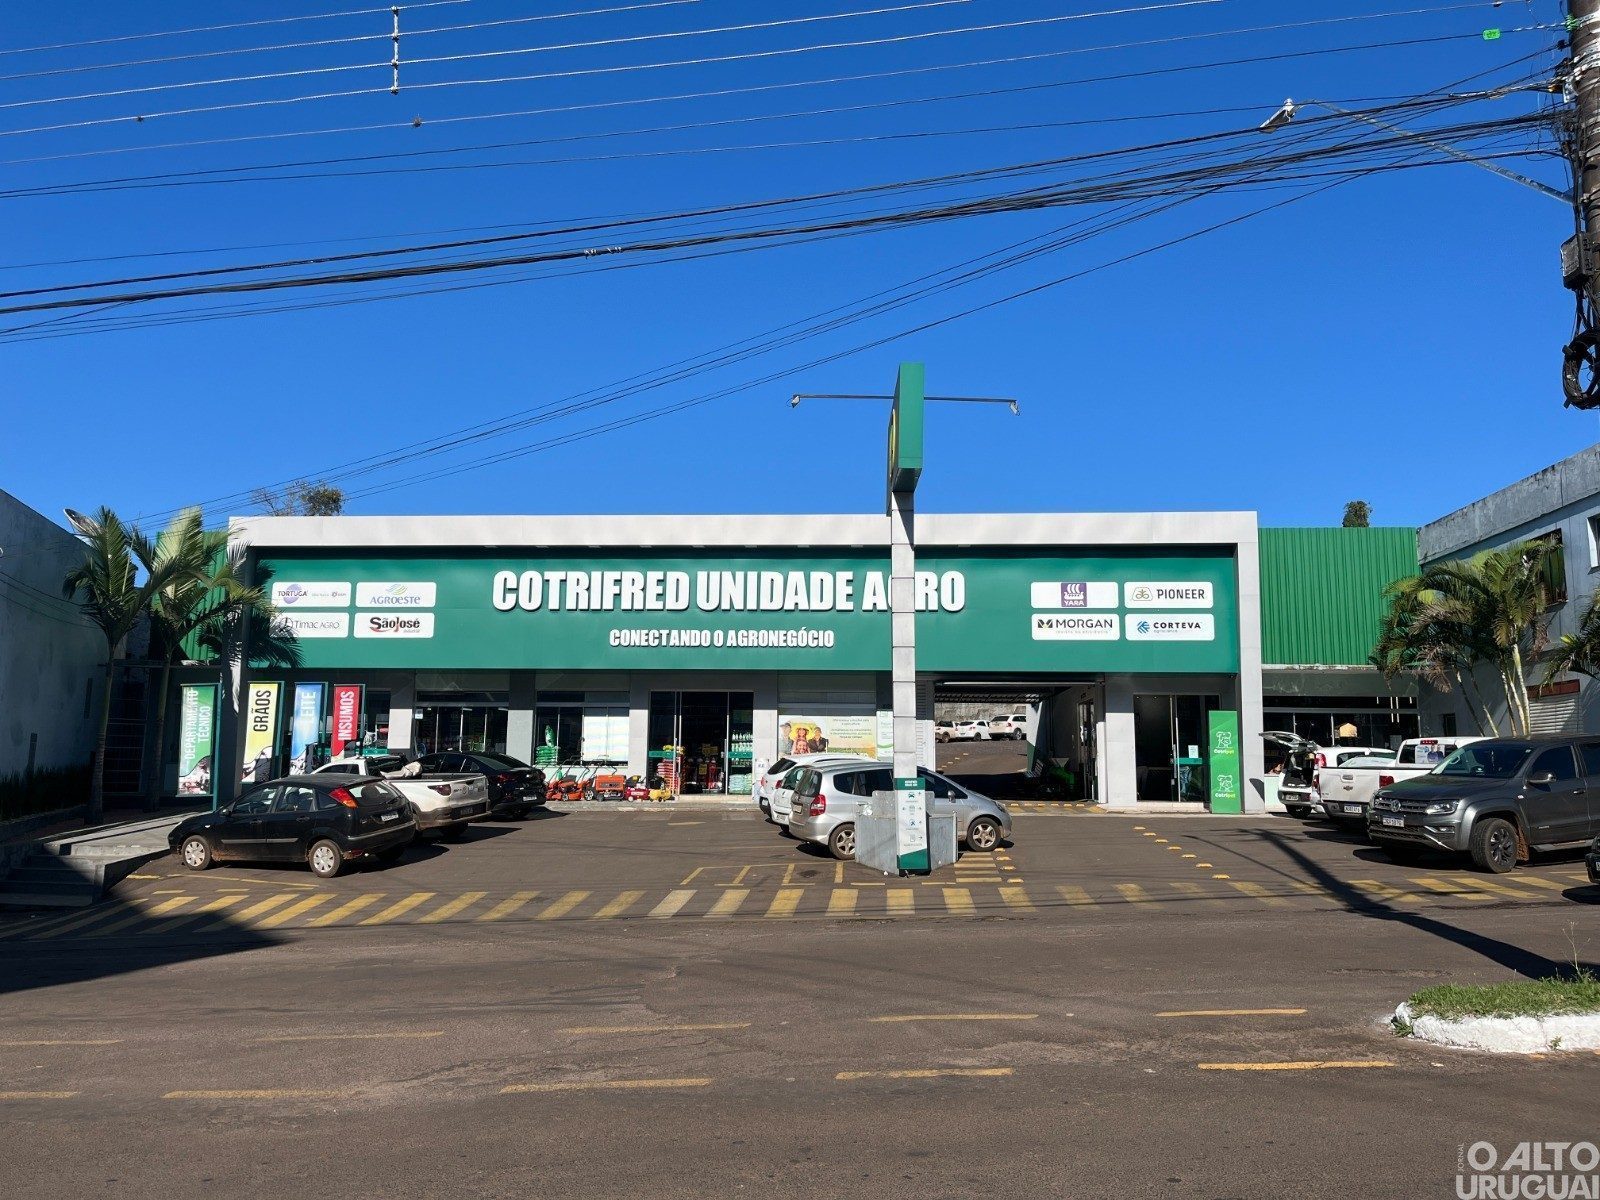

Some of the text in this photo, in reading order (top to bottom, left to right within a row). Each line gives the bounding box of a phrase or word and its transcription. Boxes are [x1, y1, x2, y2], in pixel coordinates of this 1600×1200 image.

[492, 570, 966, 612] COTRIFRED UNIDADE ARO
[1156, 588, 1205, 600] PIONEER
[320, 621, 340, 629] AGRO
[609, 626, 835, 647] CONECTANDO O AGRONEGÓCIO
[1055, 618, 1113, 629] MORGAN
[196, 705, 211, 743] TÉCNICO
[251, 690, 272, 732] GRÃOS
[337, 690, 355, 741] INSUMOS
